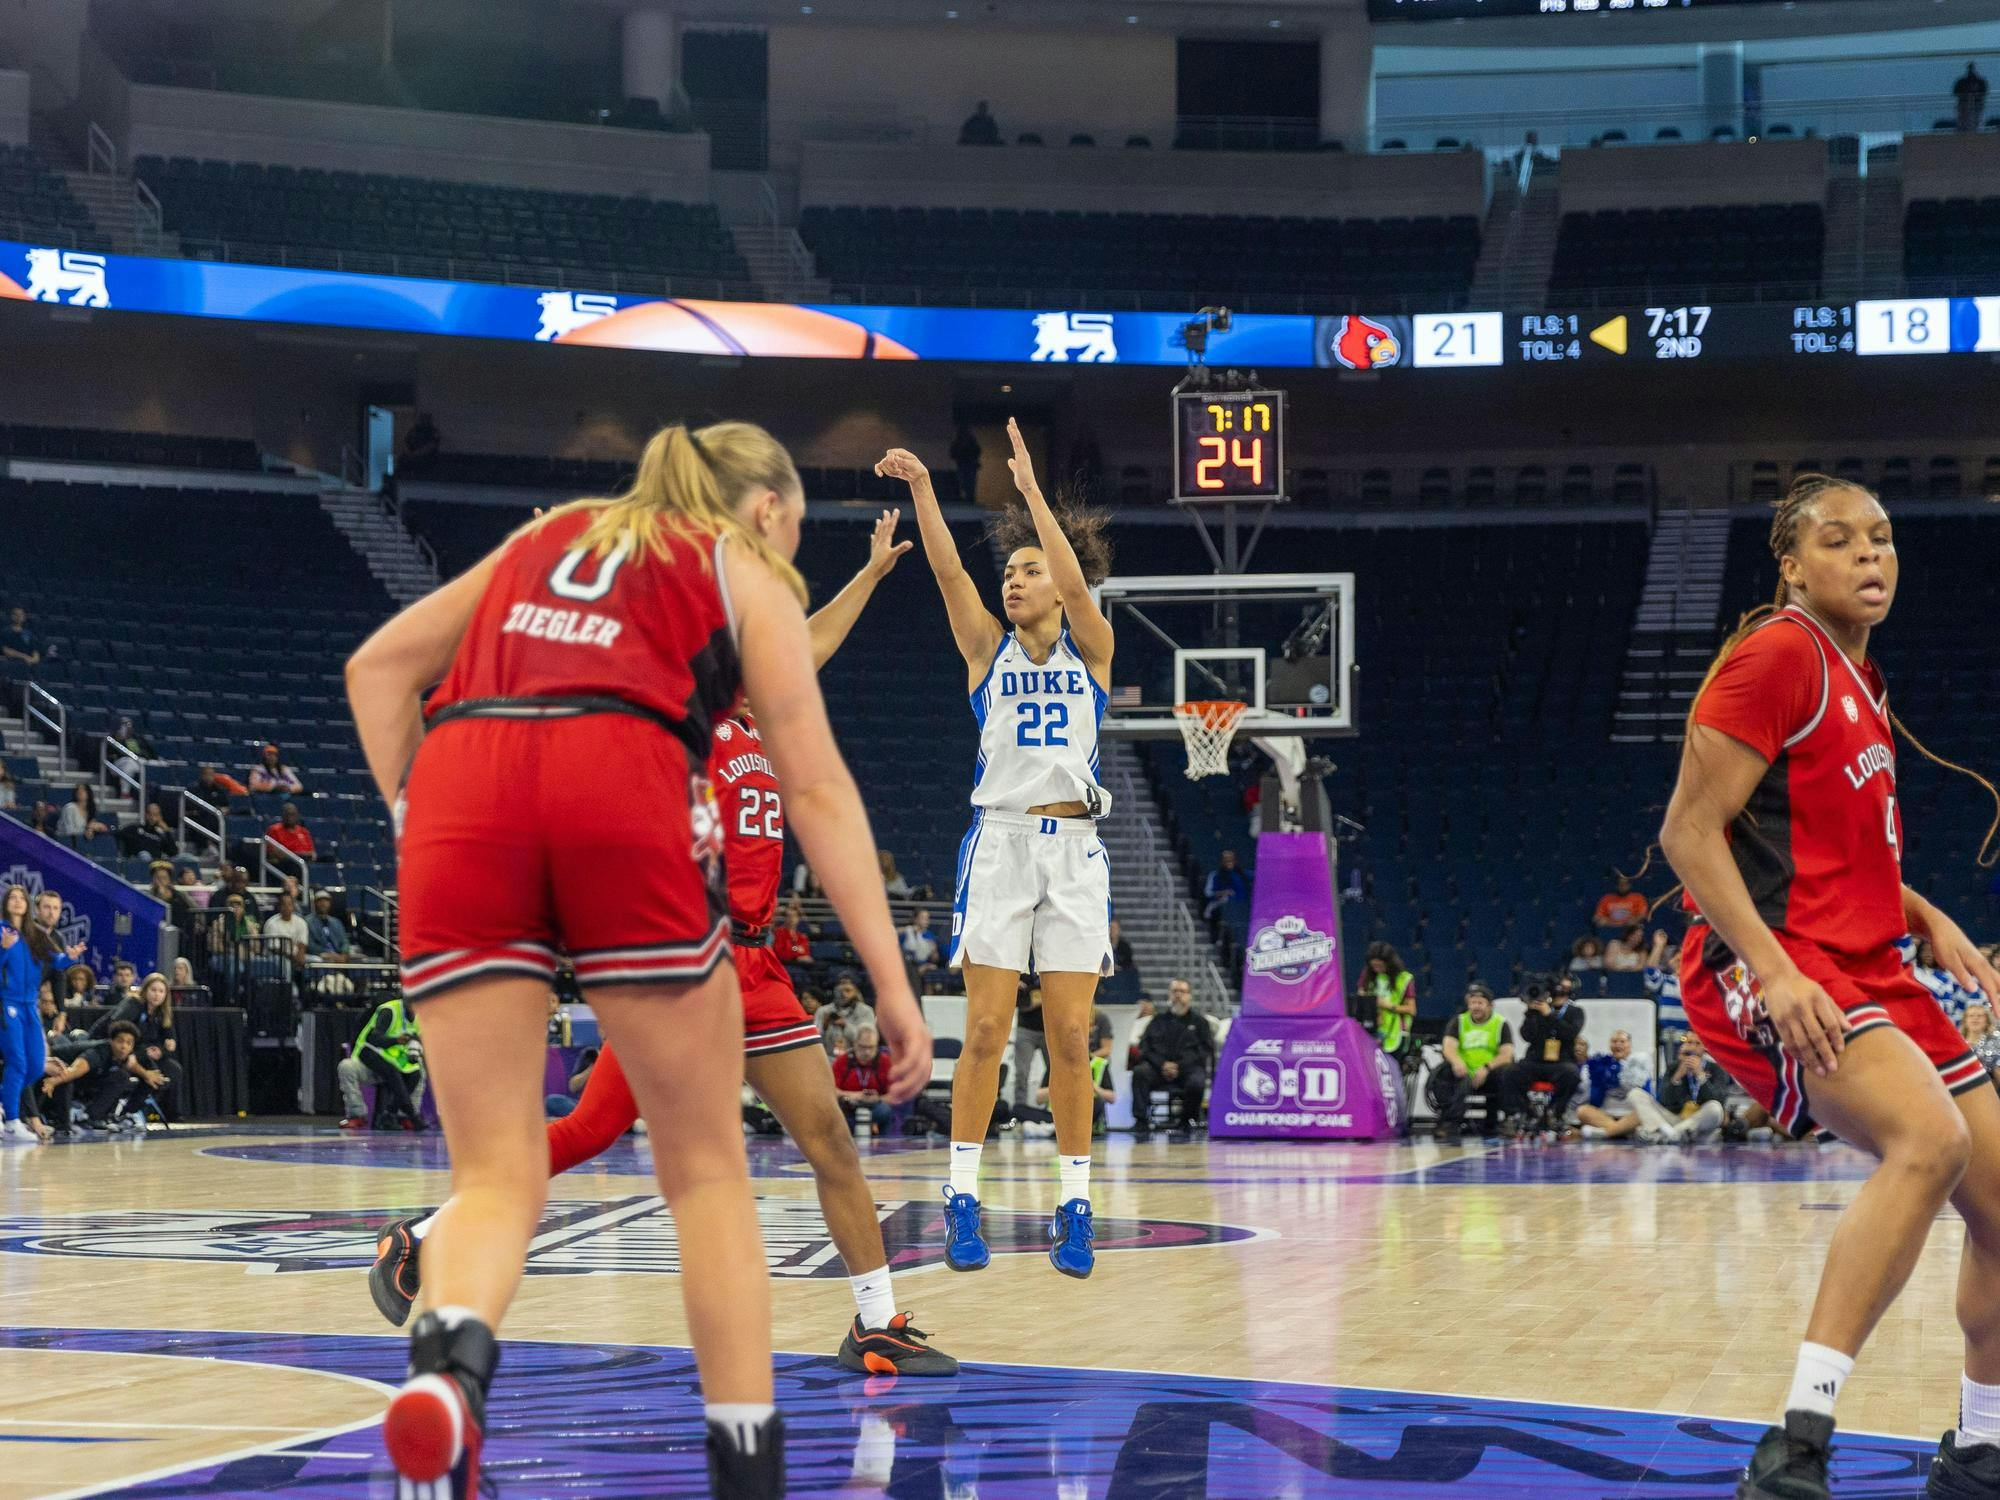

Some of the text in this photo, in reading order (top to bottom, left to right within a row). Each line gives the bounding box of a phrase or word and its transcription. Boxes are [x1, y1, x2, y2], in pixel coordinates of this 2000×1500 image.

[1522, 314, 1579, 336] FLS: 1
[1644, 306, 1712, 337] 7:17
[1793, 306, 1852, 328] FLS: 1
[1880, 306, 1930, 344] 18
[1432, 321, 1477, 358] 21
[1519, 339, 1582, 361] TOL: 4
[1656, 336, 1702, 359] 2ND
[1790, 331, 1854, 353] TOL: 4
[1207, 403, 1270, 432] 7:17
[1196, 436, 1262, 489] 24
[502, 600, 623, 649] ZIEGLER
[1001, 670, 1085, 697] DUKE
[1016, 701, 1069, 748] 22
[738, 785, 784, 840] 22
[1224, 1112, 1353, 1128] CHAMPIONSHIP GAME
